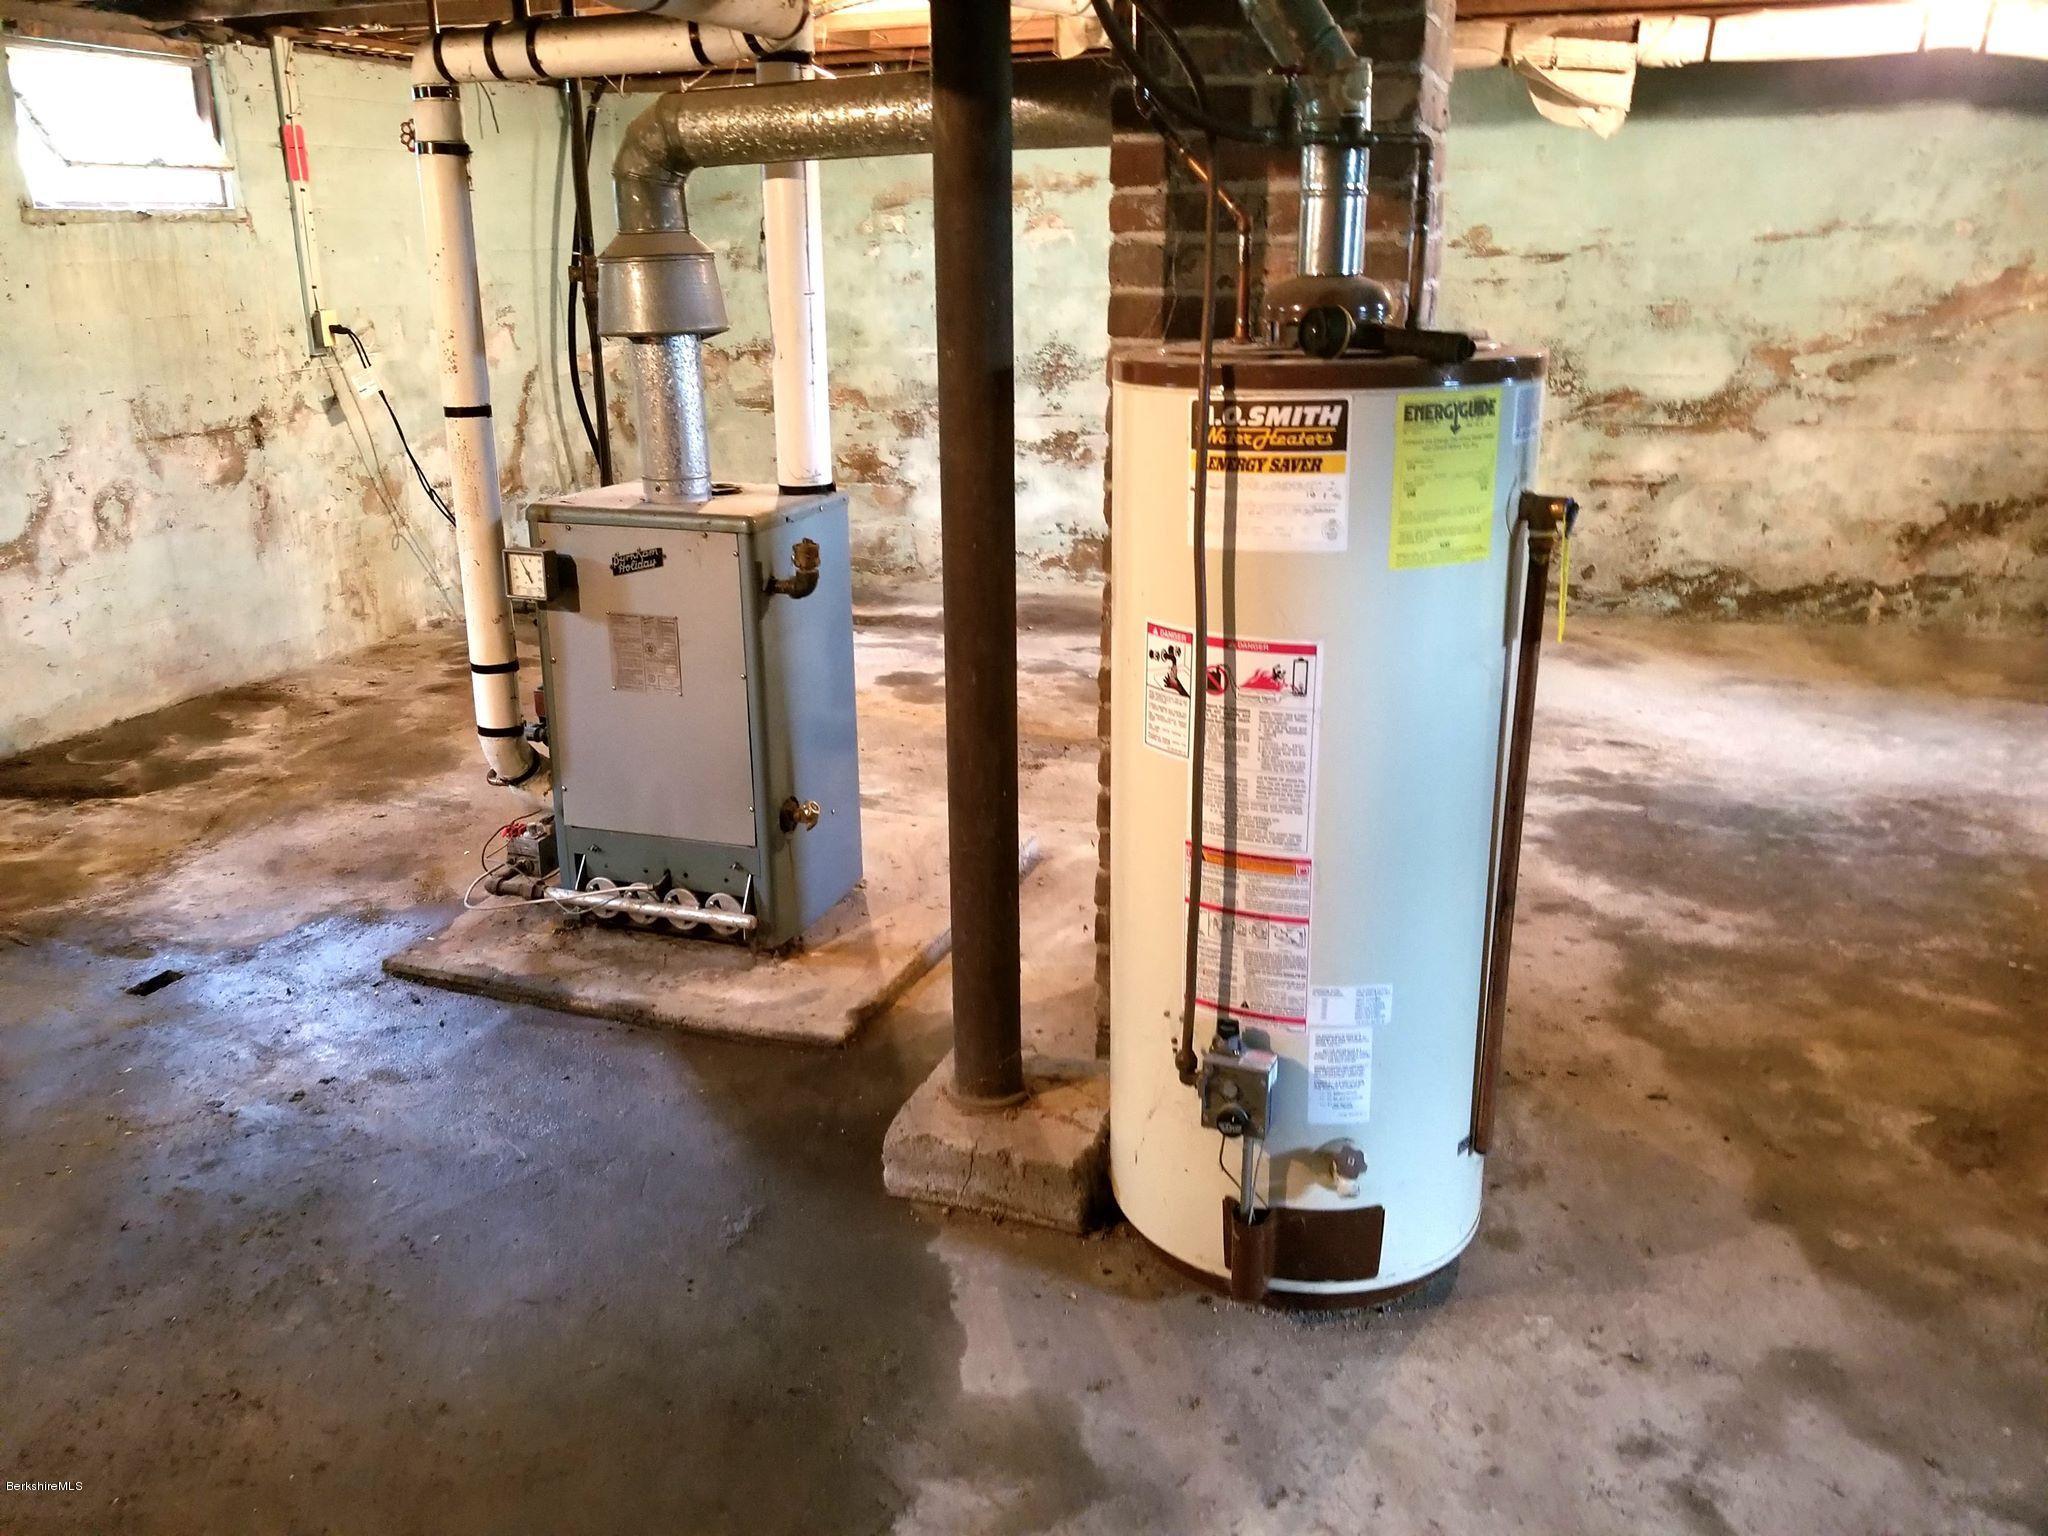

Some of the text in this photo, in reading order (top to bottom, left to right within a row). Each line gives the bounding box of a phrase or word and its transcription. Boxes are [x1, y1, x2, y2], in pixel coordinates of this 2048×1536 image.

[1206, 455, 1324, 474] ENERGY SAVER
[618, 558, 657, 573] Holiday
[1159, 627, 1187, 643] DANGER
[1237, 641, 1269, 651] DANGER
